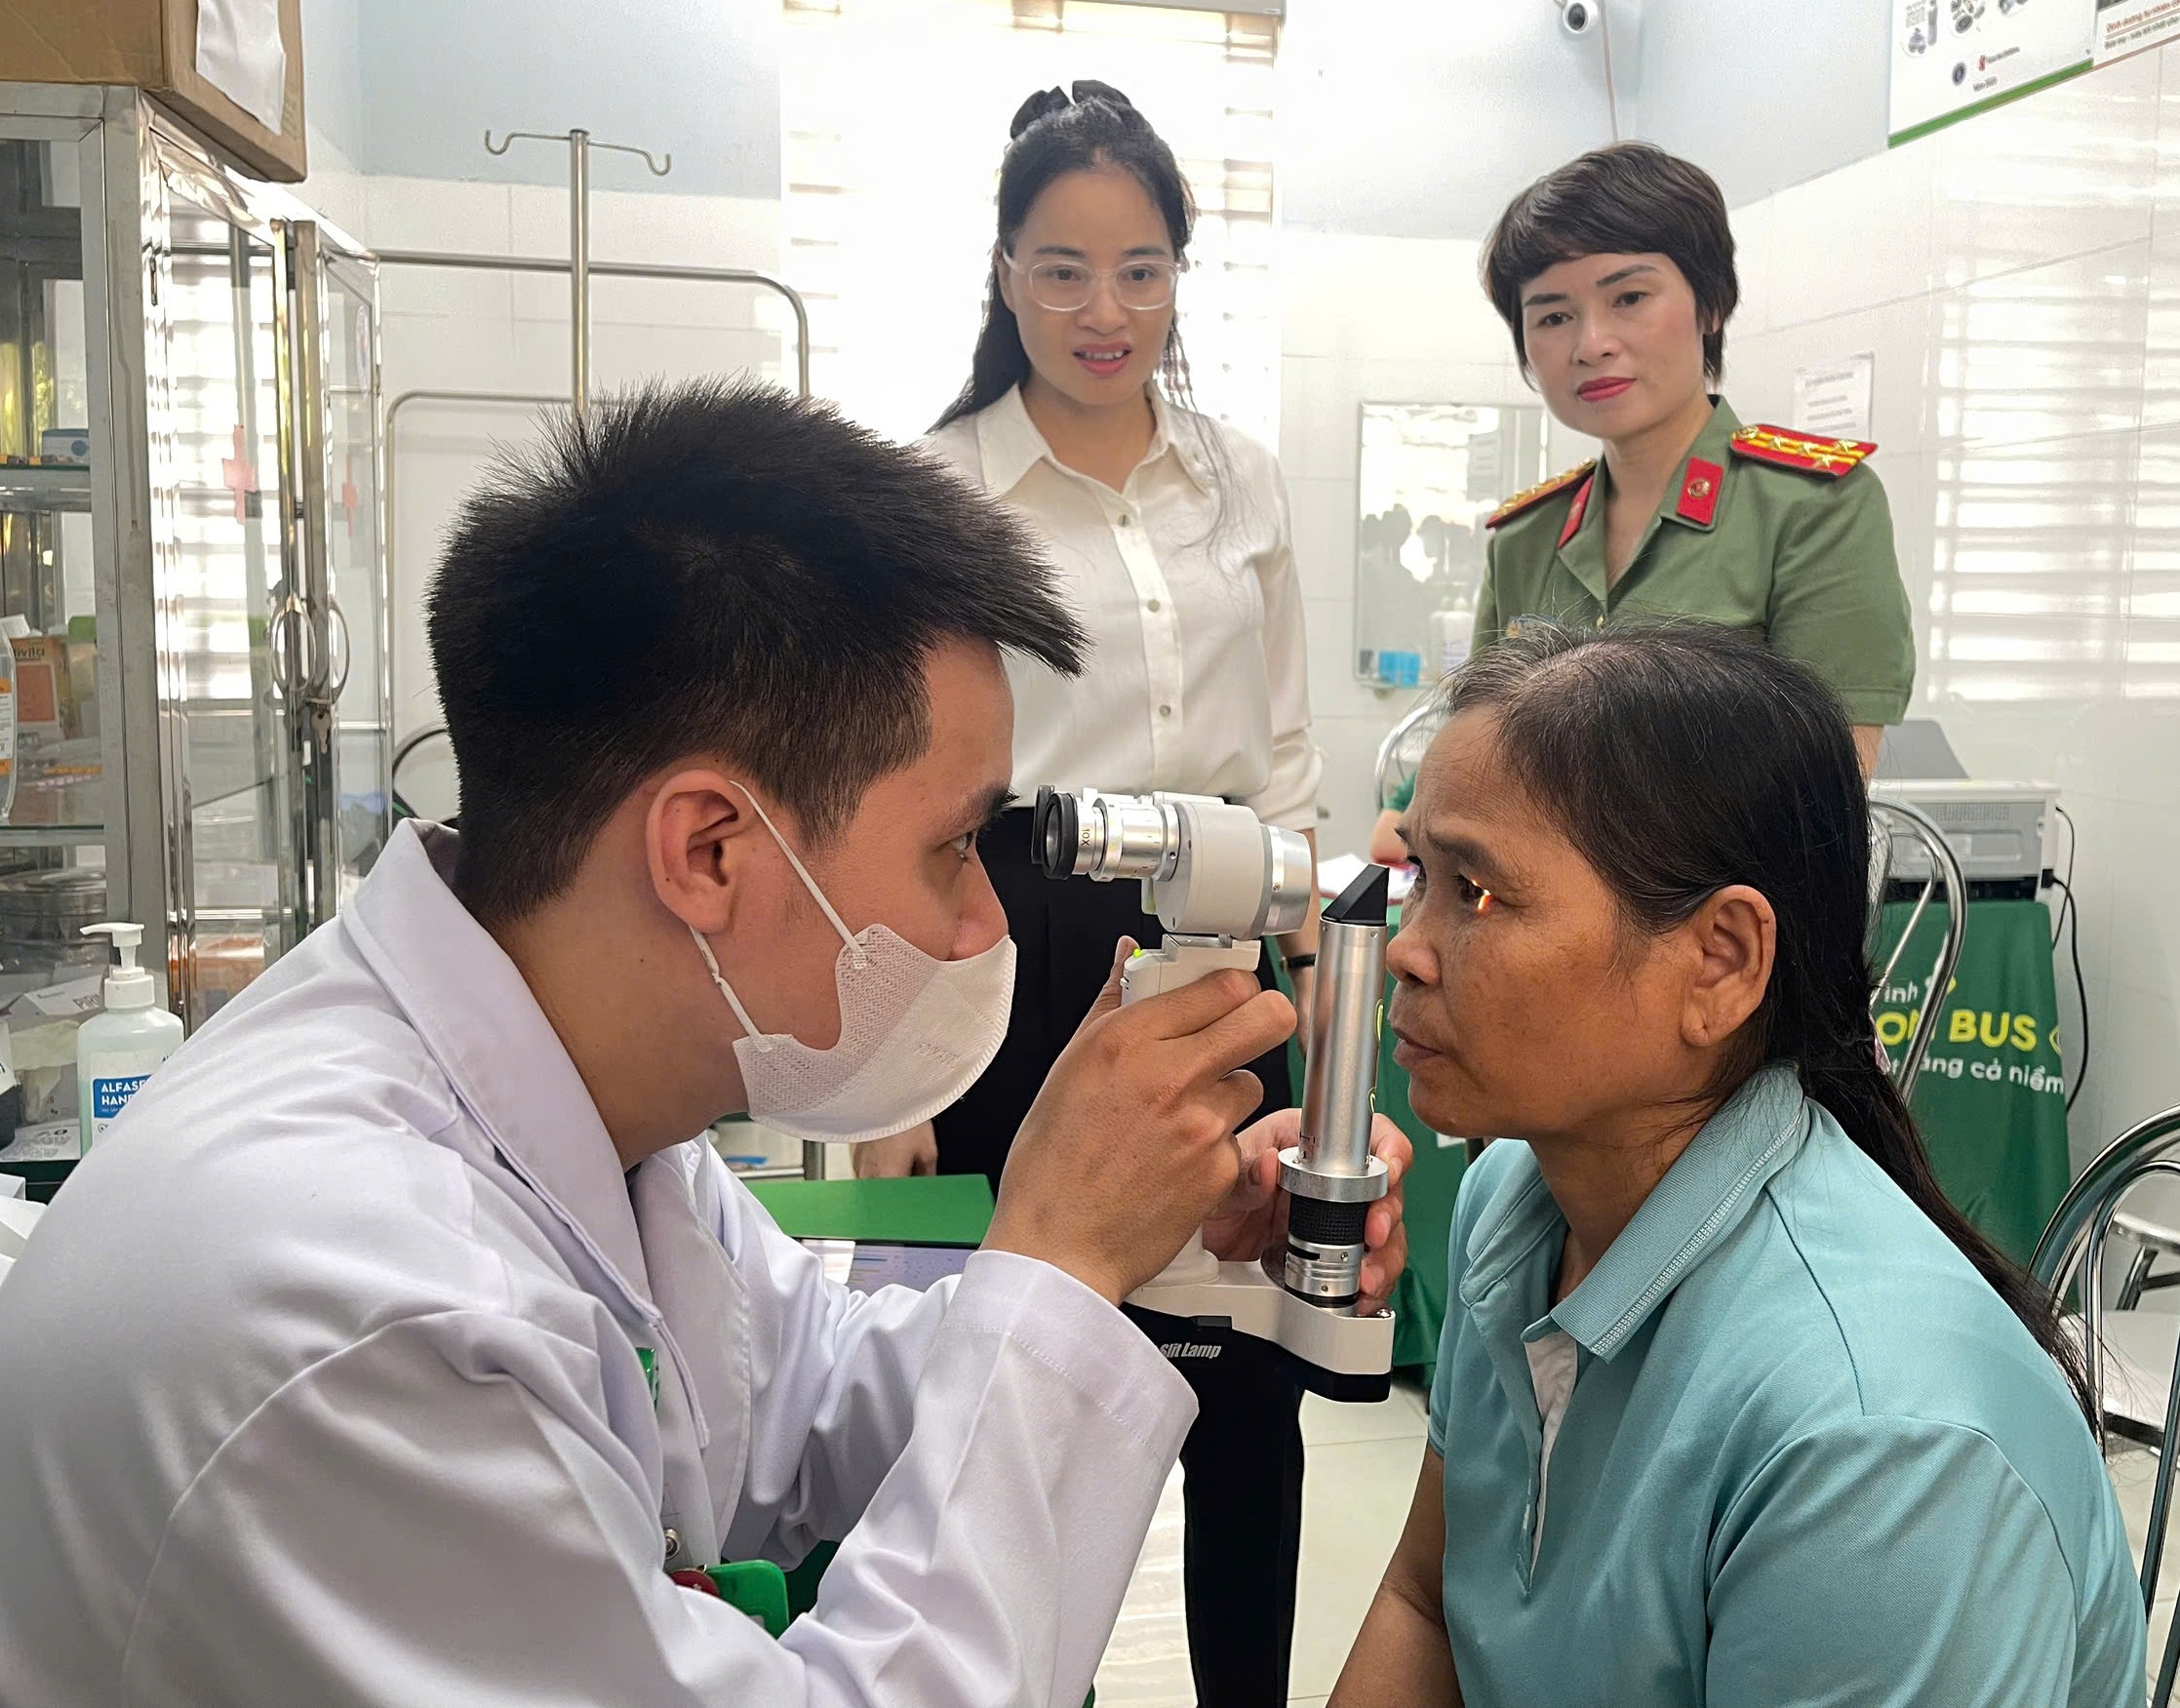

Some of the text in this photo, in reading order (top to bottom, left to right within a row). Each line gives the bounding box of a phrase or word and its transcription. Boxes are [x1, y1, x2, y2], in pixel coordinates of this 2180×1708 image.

[1082, 828, 1090, 846] 10X
[1950, 1009, 2037, 1052] BUS
[101, 1094, 132, 1106] HAN
[1181, 1342, 1222, 1359] Lamp
